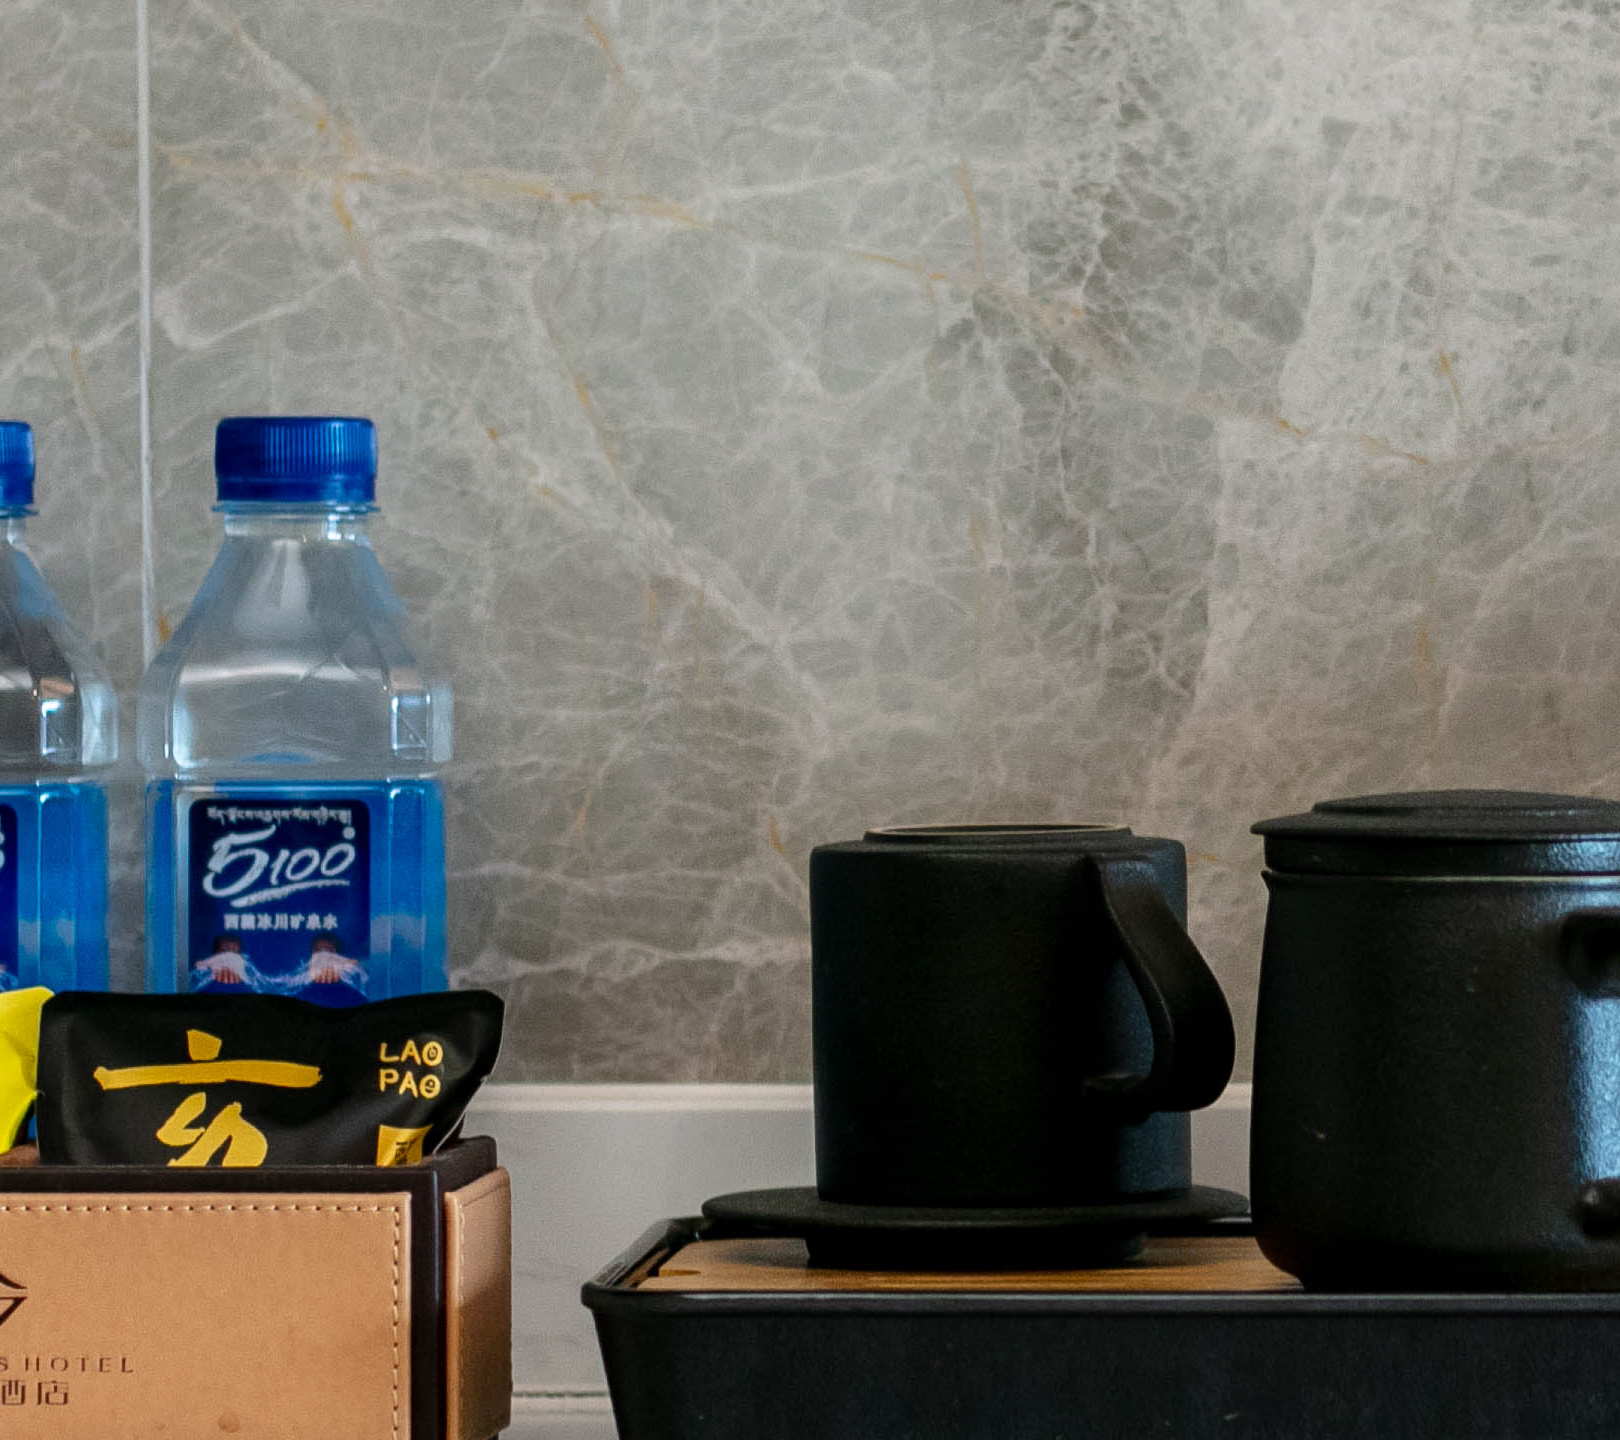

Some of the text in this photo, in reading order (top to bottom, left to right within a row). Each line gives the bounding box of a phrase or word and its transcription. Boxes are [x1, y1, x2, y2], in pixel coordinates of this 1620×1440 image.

[202, 824, 355, 897] 5100
[223, 913, 337, 930] 西藏冰川矿泉水
[378, 1039, 444, 1067] LAO
[378, 1068, 442, 1099] PAO
[24, 1356, 135, 1373] HOTEL
